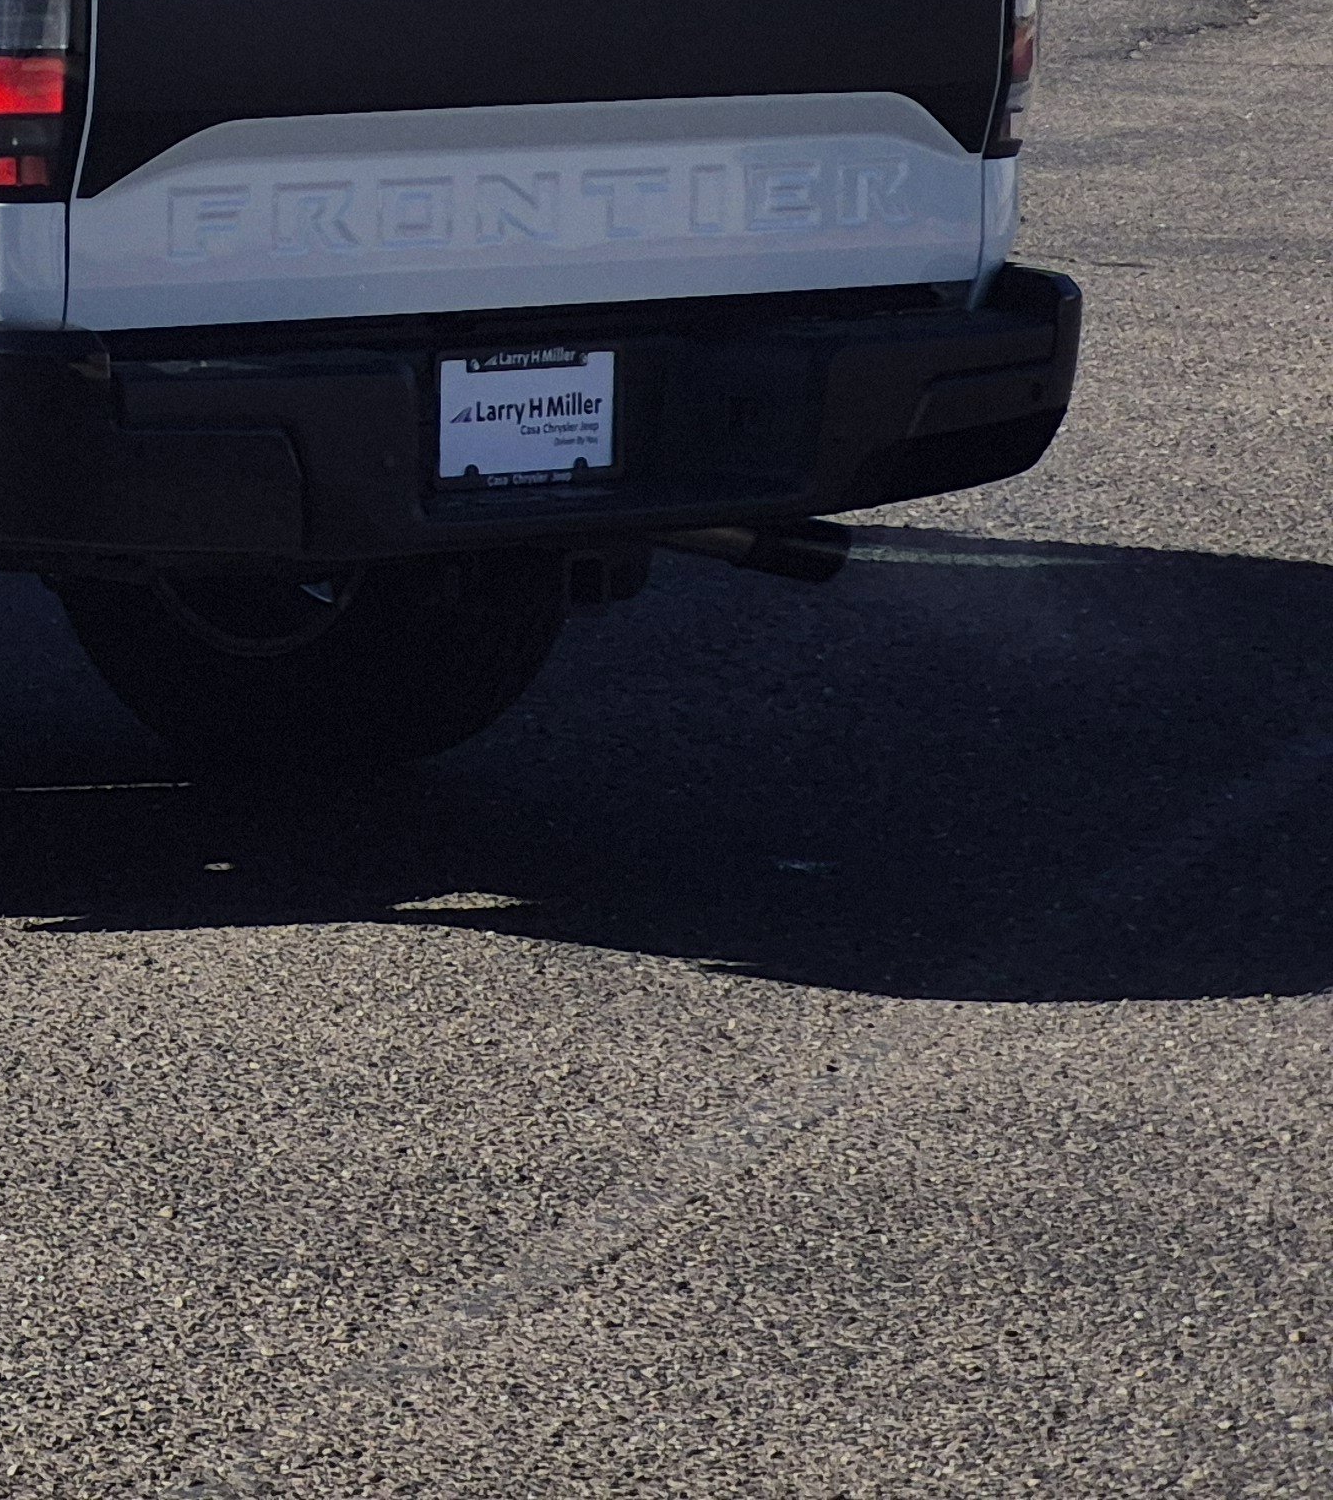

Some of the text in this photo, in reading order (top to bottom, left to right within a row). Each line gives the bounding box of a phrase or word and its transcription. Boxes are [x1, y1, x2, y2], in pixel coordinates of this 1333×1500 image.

[166, 159, 915, 260] FRONTIER
[498, 347, 576, 367] Larry H Miller
[476, 391, 603, 425] Larry H Miller
[520, 424, 541, 435] Casa
[543, 421, 579, 435] Chrysler
